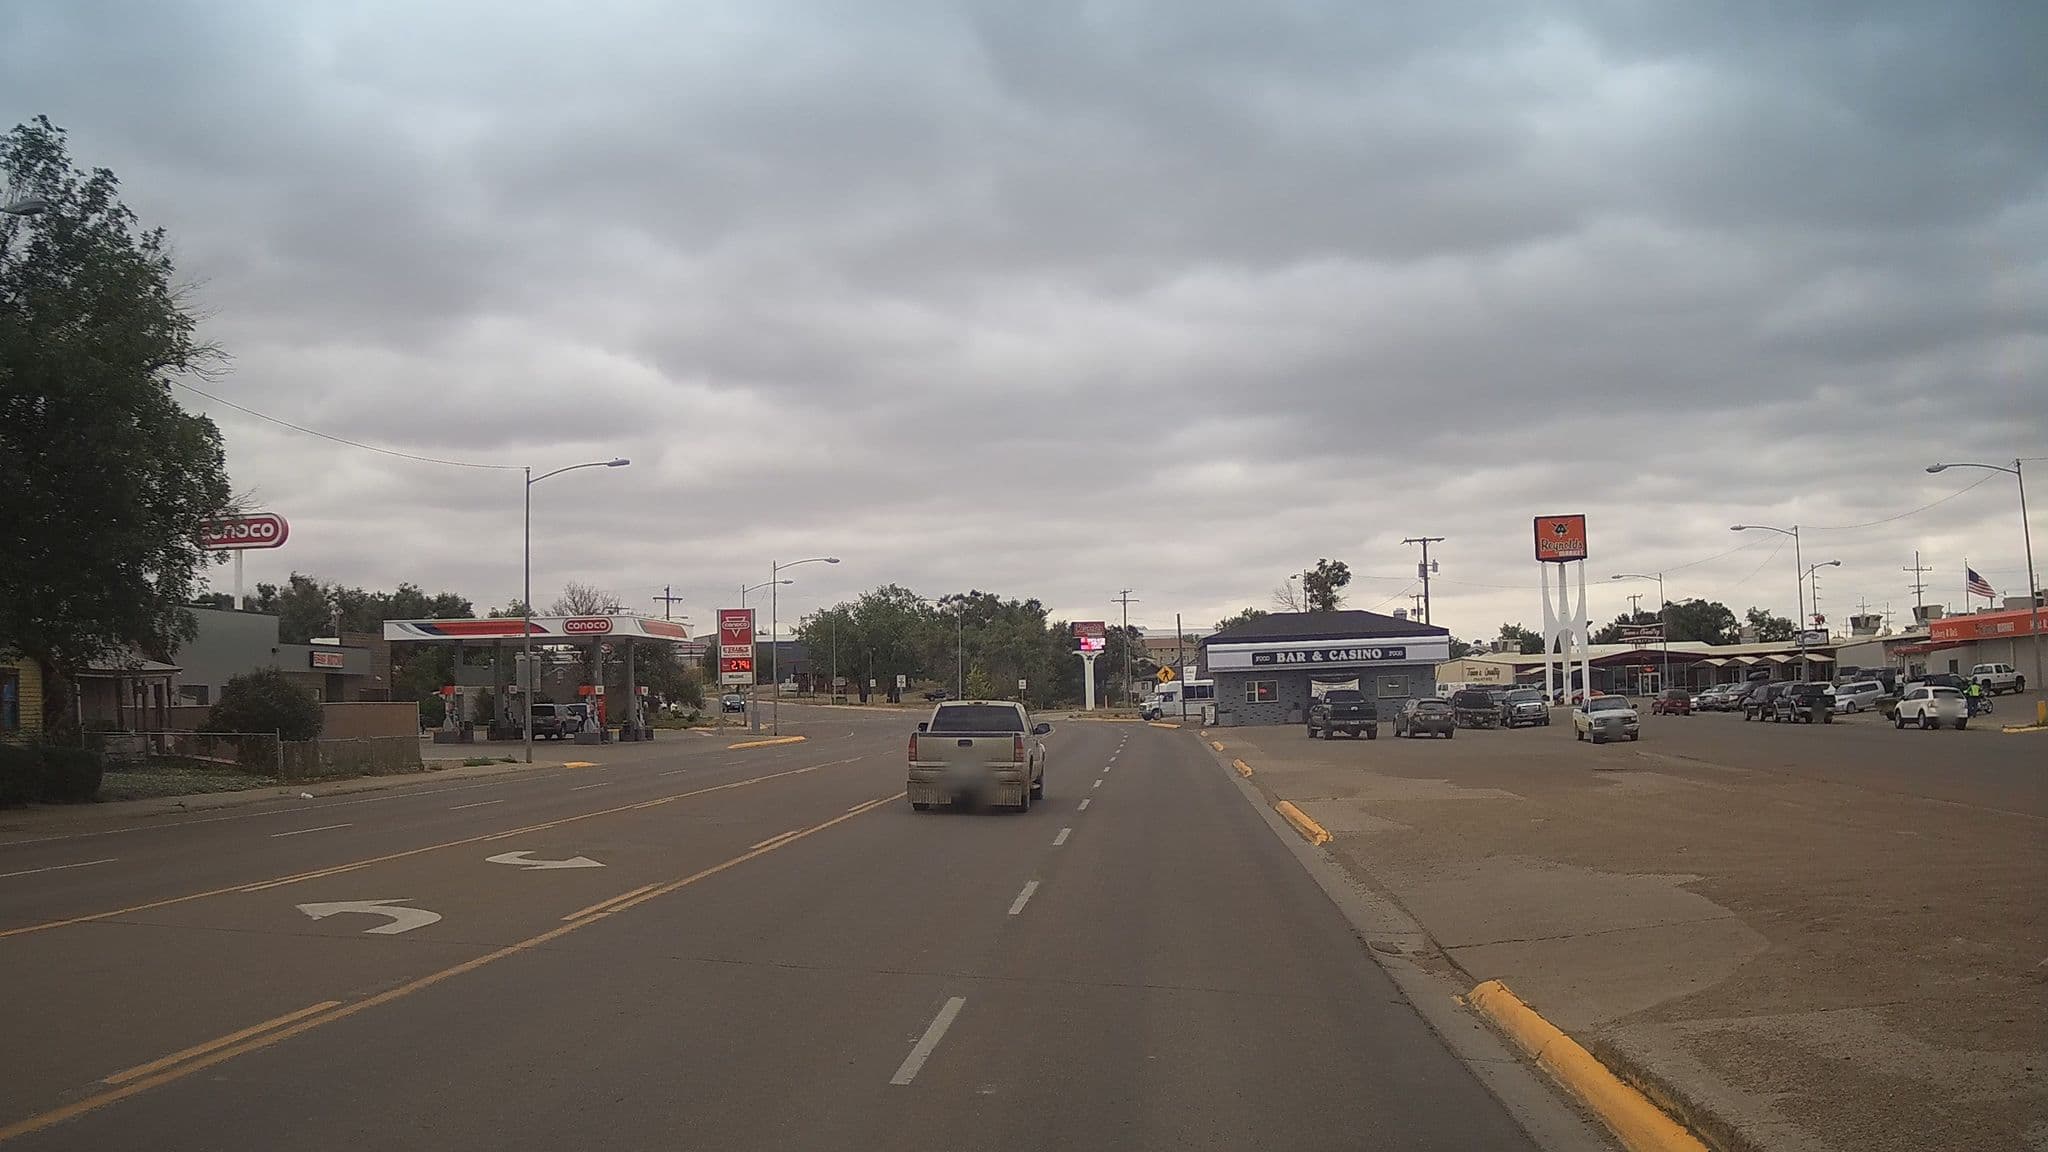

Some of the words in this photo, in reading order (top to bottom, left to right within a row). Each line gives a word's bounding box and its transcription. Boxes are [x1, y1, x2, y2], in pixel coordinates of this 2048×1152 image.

[1541, 538, 1584, 551] Reynolds
[567, 621, 607, 630] conoco
[1276, 652, 1306, 663] BAR
[1312, 651, 1323, 661] &
[1329, 648, 1382, 661] CASINO
